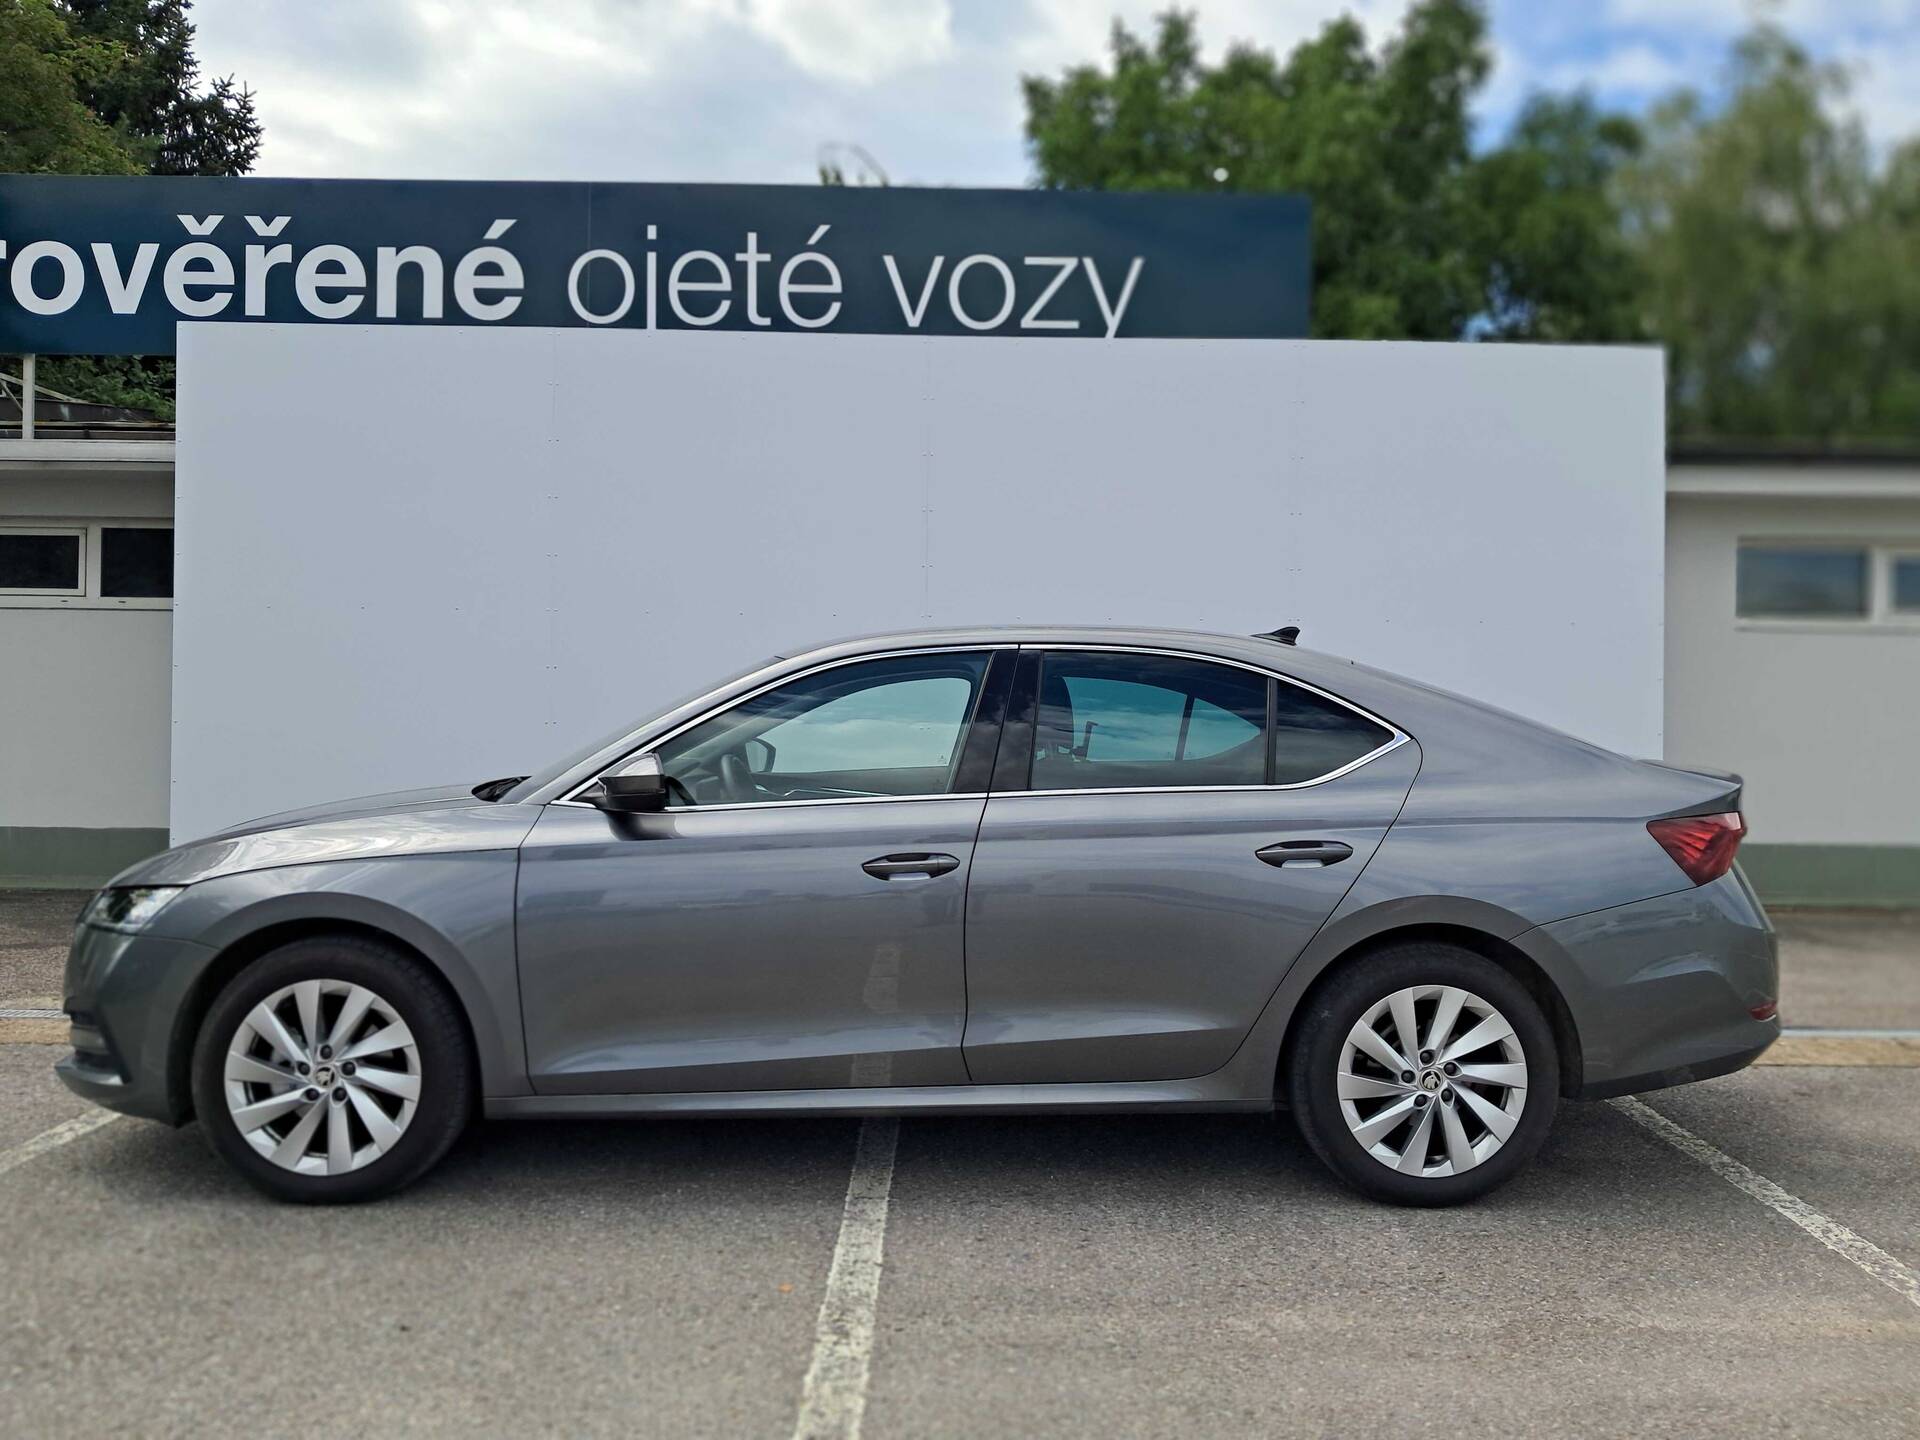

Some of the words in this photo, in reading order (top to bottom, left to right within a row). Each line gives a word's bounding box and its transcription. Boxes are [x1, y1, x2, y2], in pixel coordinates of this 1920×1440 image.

[0, 214, 525, 321] ověřené
[567, 224, 843, 331] ojeté
[883, 253, 1145, 339] vozy
